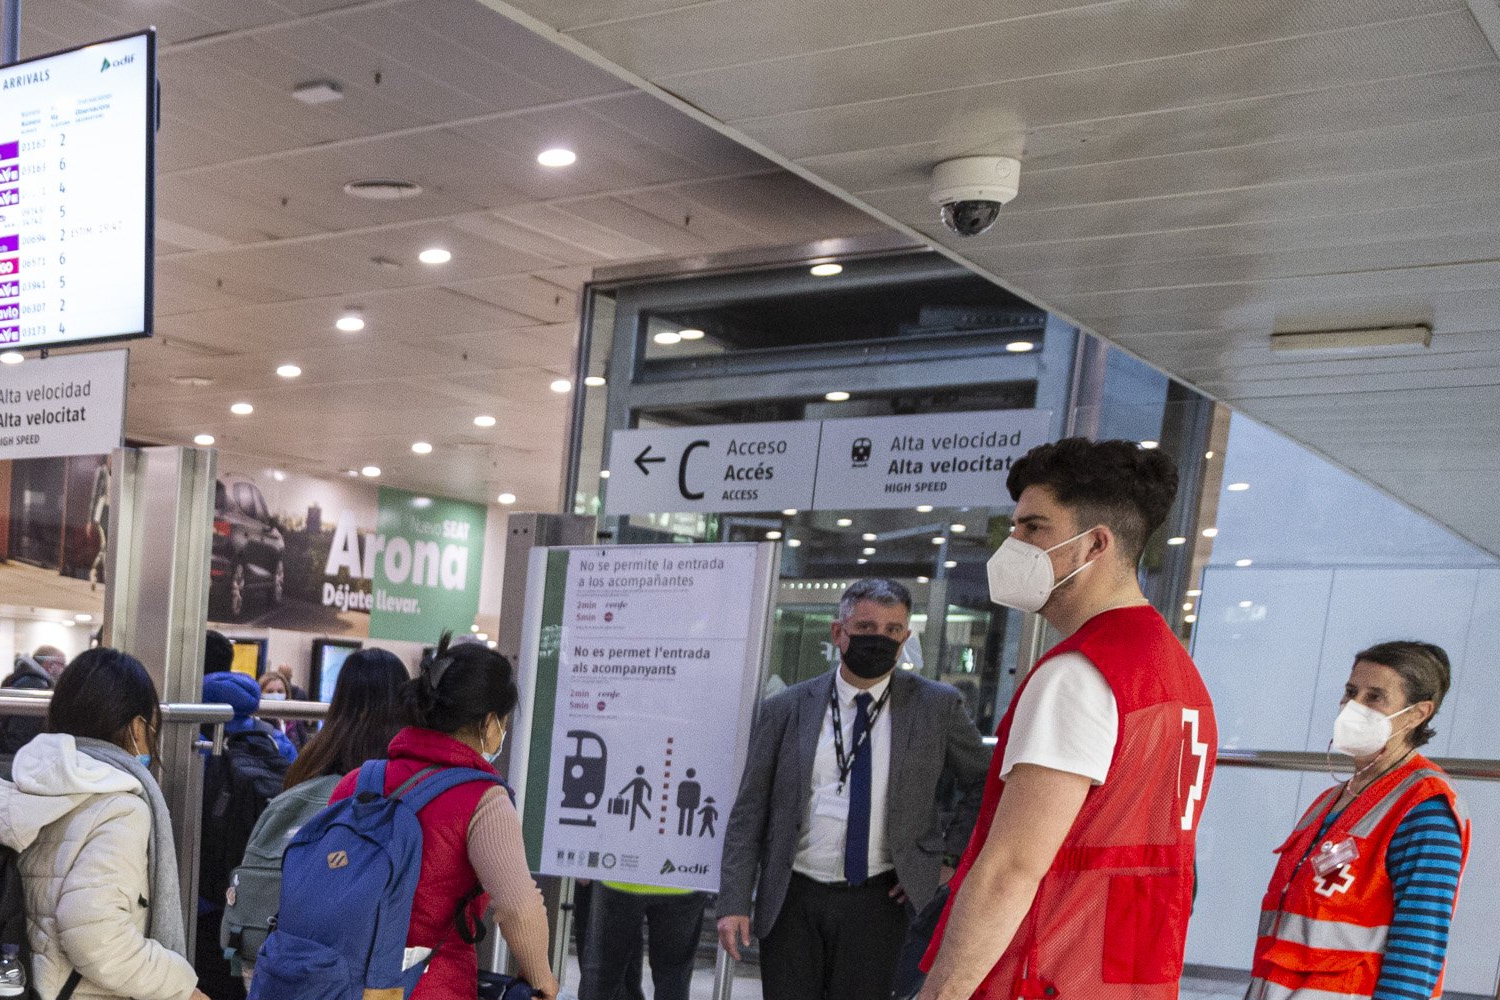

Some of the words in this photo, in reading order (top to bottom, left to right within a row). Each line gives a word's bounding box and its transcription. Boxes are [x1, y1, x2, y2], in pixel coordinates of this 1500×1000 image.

[112, 54, 135, 67] adif
[3, 69, 50, 91] ARRIVALS
[60, 133, 66, 146] 2
[60, 157, 66, 170] 6
[59, 181, 66, 194] 4
[60, 206, 66, 218] 5
[60, 229, 66, 242] 2
[60, 252, 66, 266] 6
[60, 275, 66, 289] 5
[60, 299, 66, 312] 2
[59, 322, 66, 335] 4
[25, 380, 92, 403] velocidad
[26, 406, 86, 428] velocitat
[16, 434, 40, 446] SPEED
[890, 436, 924, 452] Alta
[931, 430, 1022, 451] velocidad
[678, 440, 710, 501] C
[726, 439, 788, 456] Acceso
[723, 461, 774, 481] Accés
[887, 458, 924, 475] Alta
[930, 455, 1013, 474] velocitat
[884, 482, 911, 494] HIGH
[914, 480, 947, 493] SPEED
[721, 489, 759, 501] ACCESS
[443, 520, 471, 541] SEAT
[324, 509, 469, 591] Arona
[580, 560, 594, 571] No
[598, 562, 610, 571] se
[614, 559, 659, 573] permite
[663, 559, 673, 570] la
[678, 558, 724, 570] entrada
[578, 577, 585, 587] a
[589, 576, 604, 587] los
[608, 574, 694, 588] acompañantes
[322, 582, 373, 612] Déjate
[376, 588, 421, 614] llevar.
[574, 646, 588, 657] No
[593, 648, 605, 657] es
[608, 647, 651, 660] permet
[655, 647, 711, 659] l'entrada
[572, 662, 588, 673] als
[592, 664, 677, 677] acompanyants
[677, 864, 710, 875] adif
